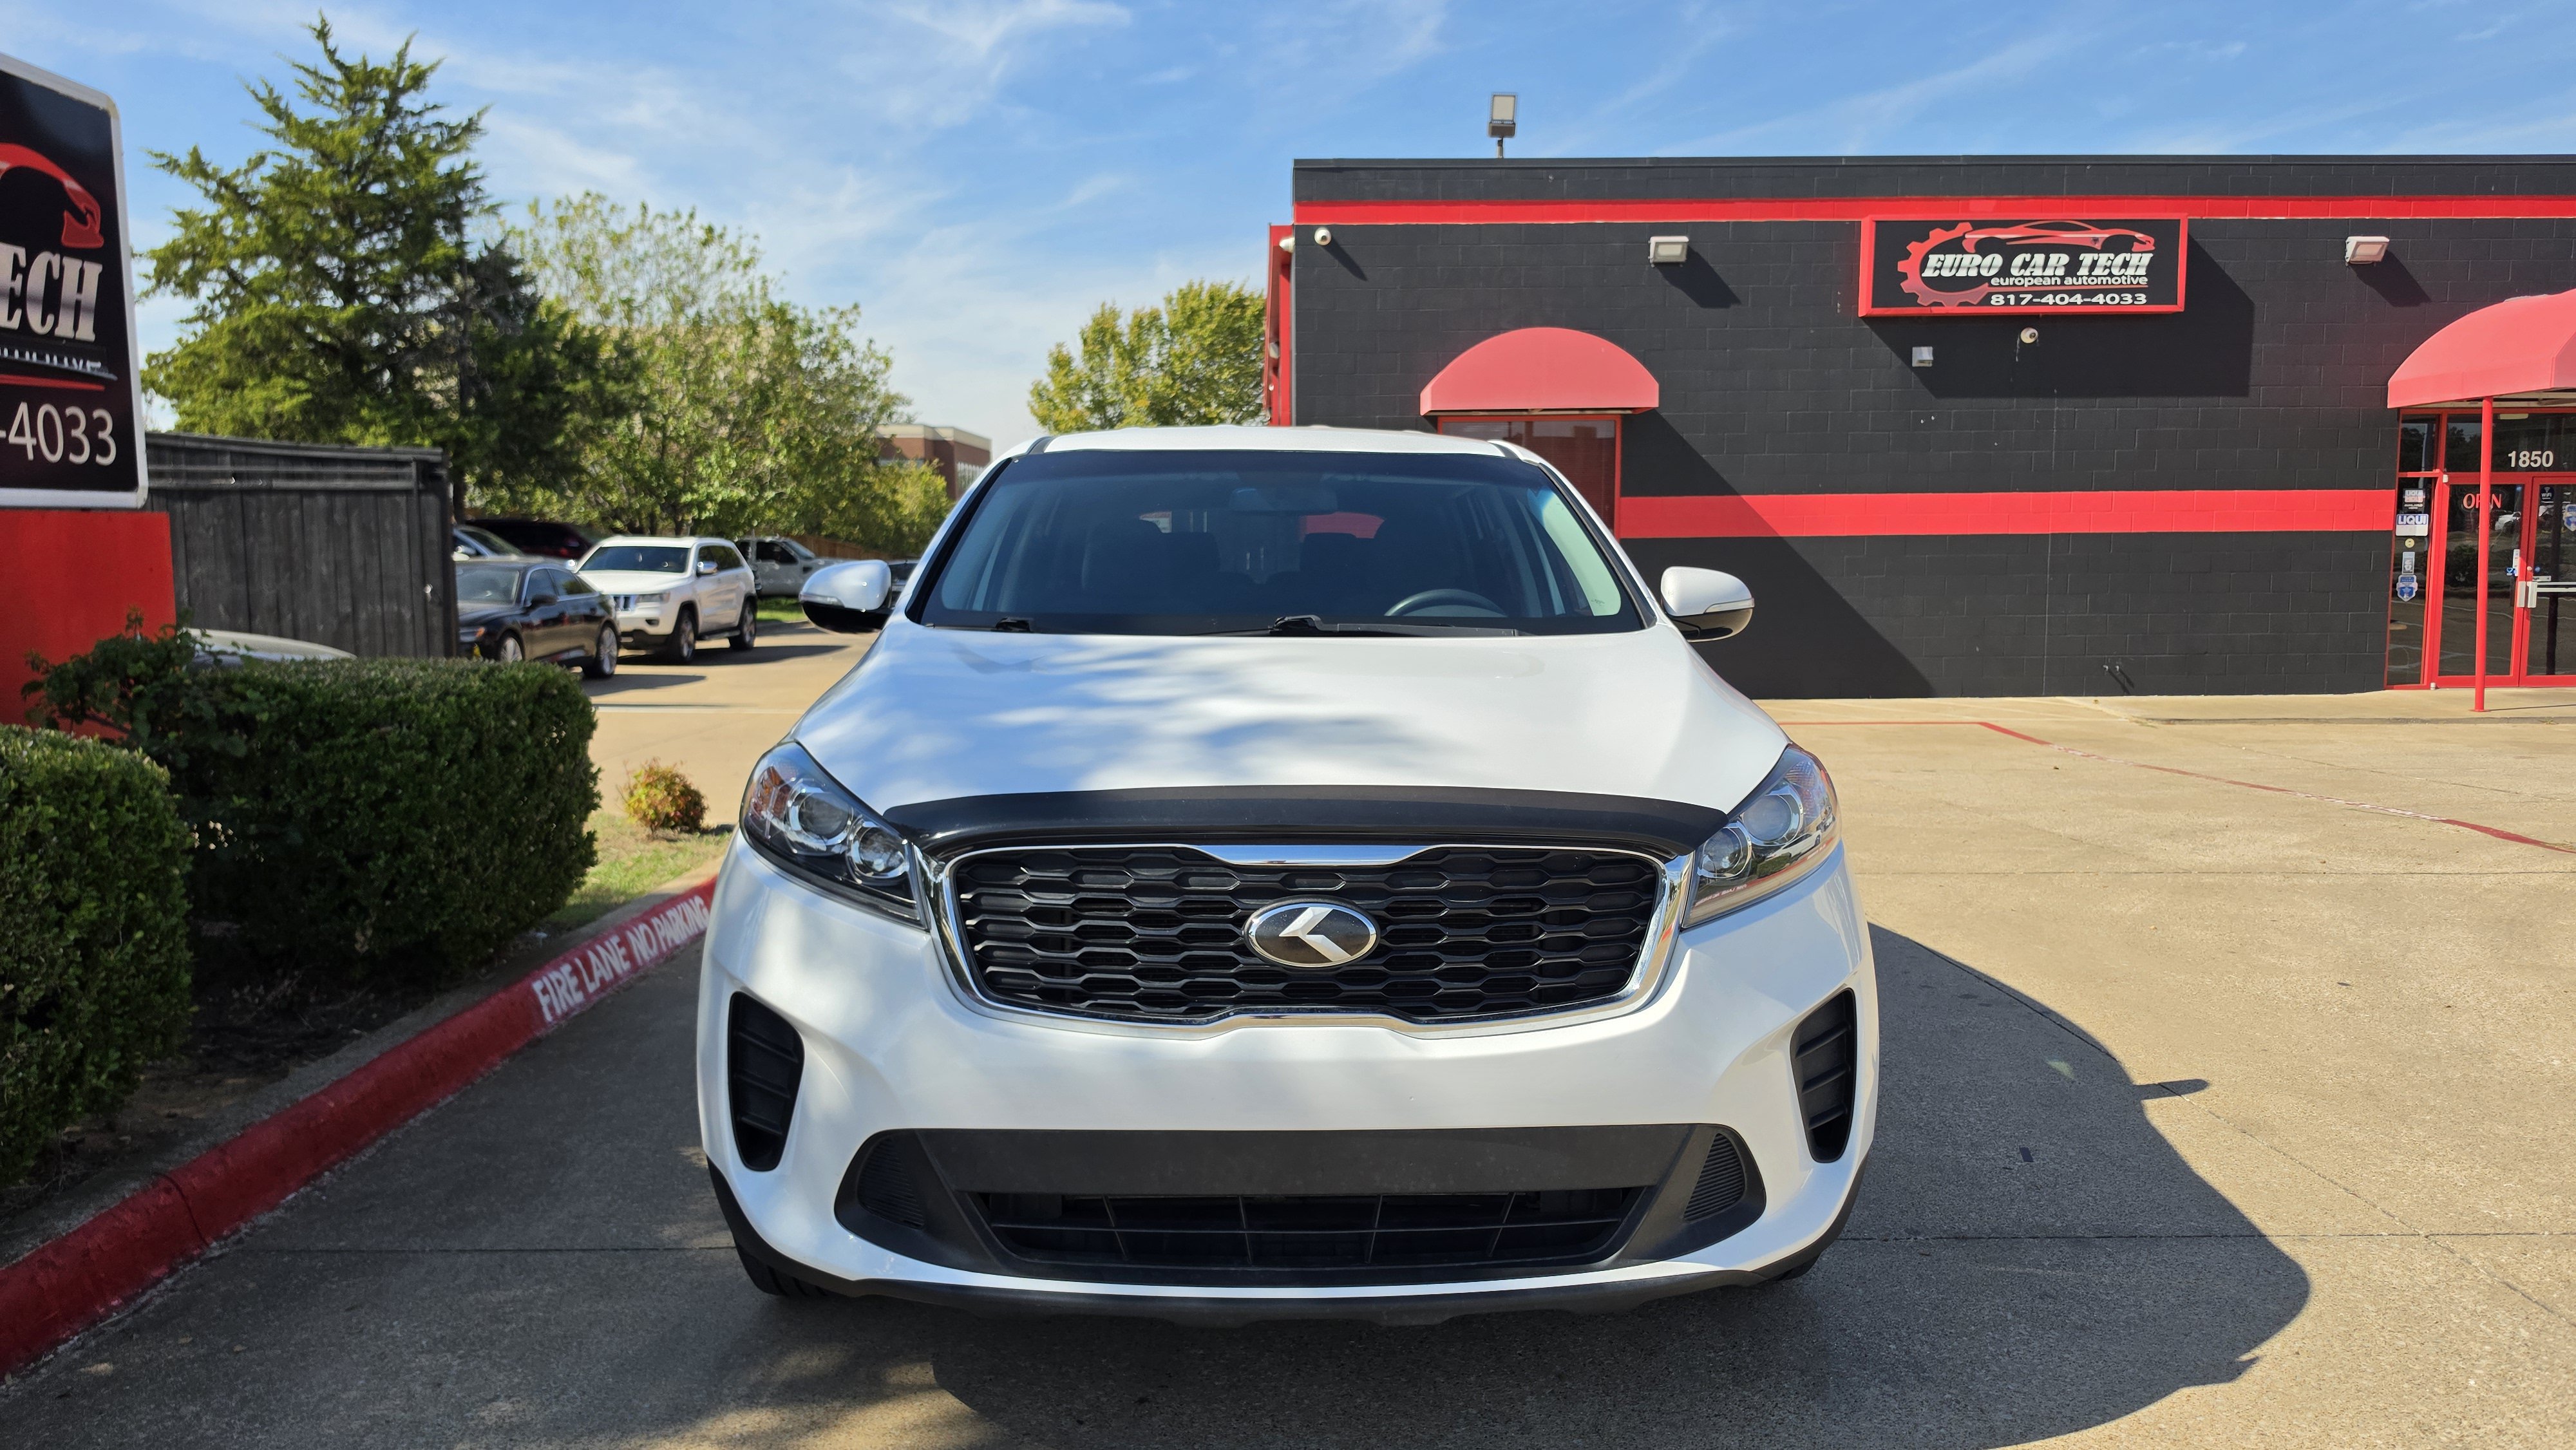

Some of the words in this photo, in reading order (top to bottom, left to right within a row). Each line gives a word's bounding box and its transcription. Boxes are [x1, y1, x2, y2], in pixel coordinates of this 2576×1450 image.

[1922, 253, 2003, 277] EURO
[2010, 253, 2070, 277] CAR
[2076, 252, 2154, 276] TECH
[1991, 276, 2061, 287] european
[2063, 274, 2148, 285] automotive
[1990, 293, 2147, 306] 817-404-4033
[2508, 450, 2554, 468] 1850
[2463, 493, 2503, 509] ON
[2398, 514, 2427, 525] LIQUI
[532, 963, 585, 1022] FIRE
[574, 935, 631, 994] LANE
[626, 923, 659, 966] NO
[651, 895, 709, 953] PARKING
